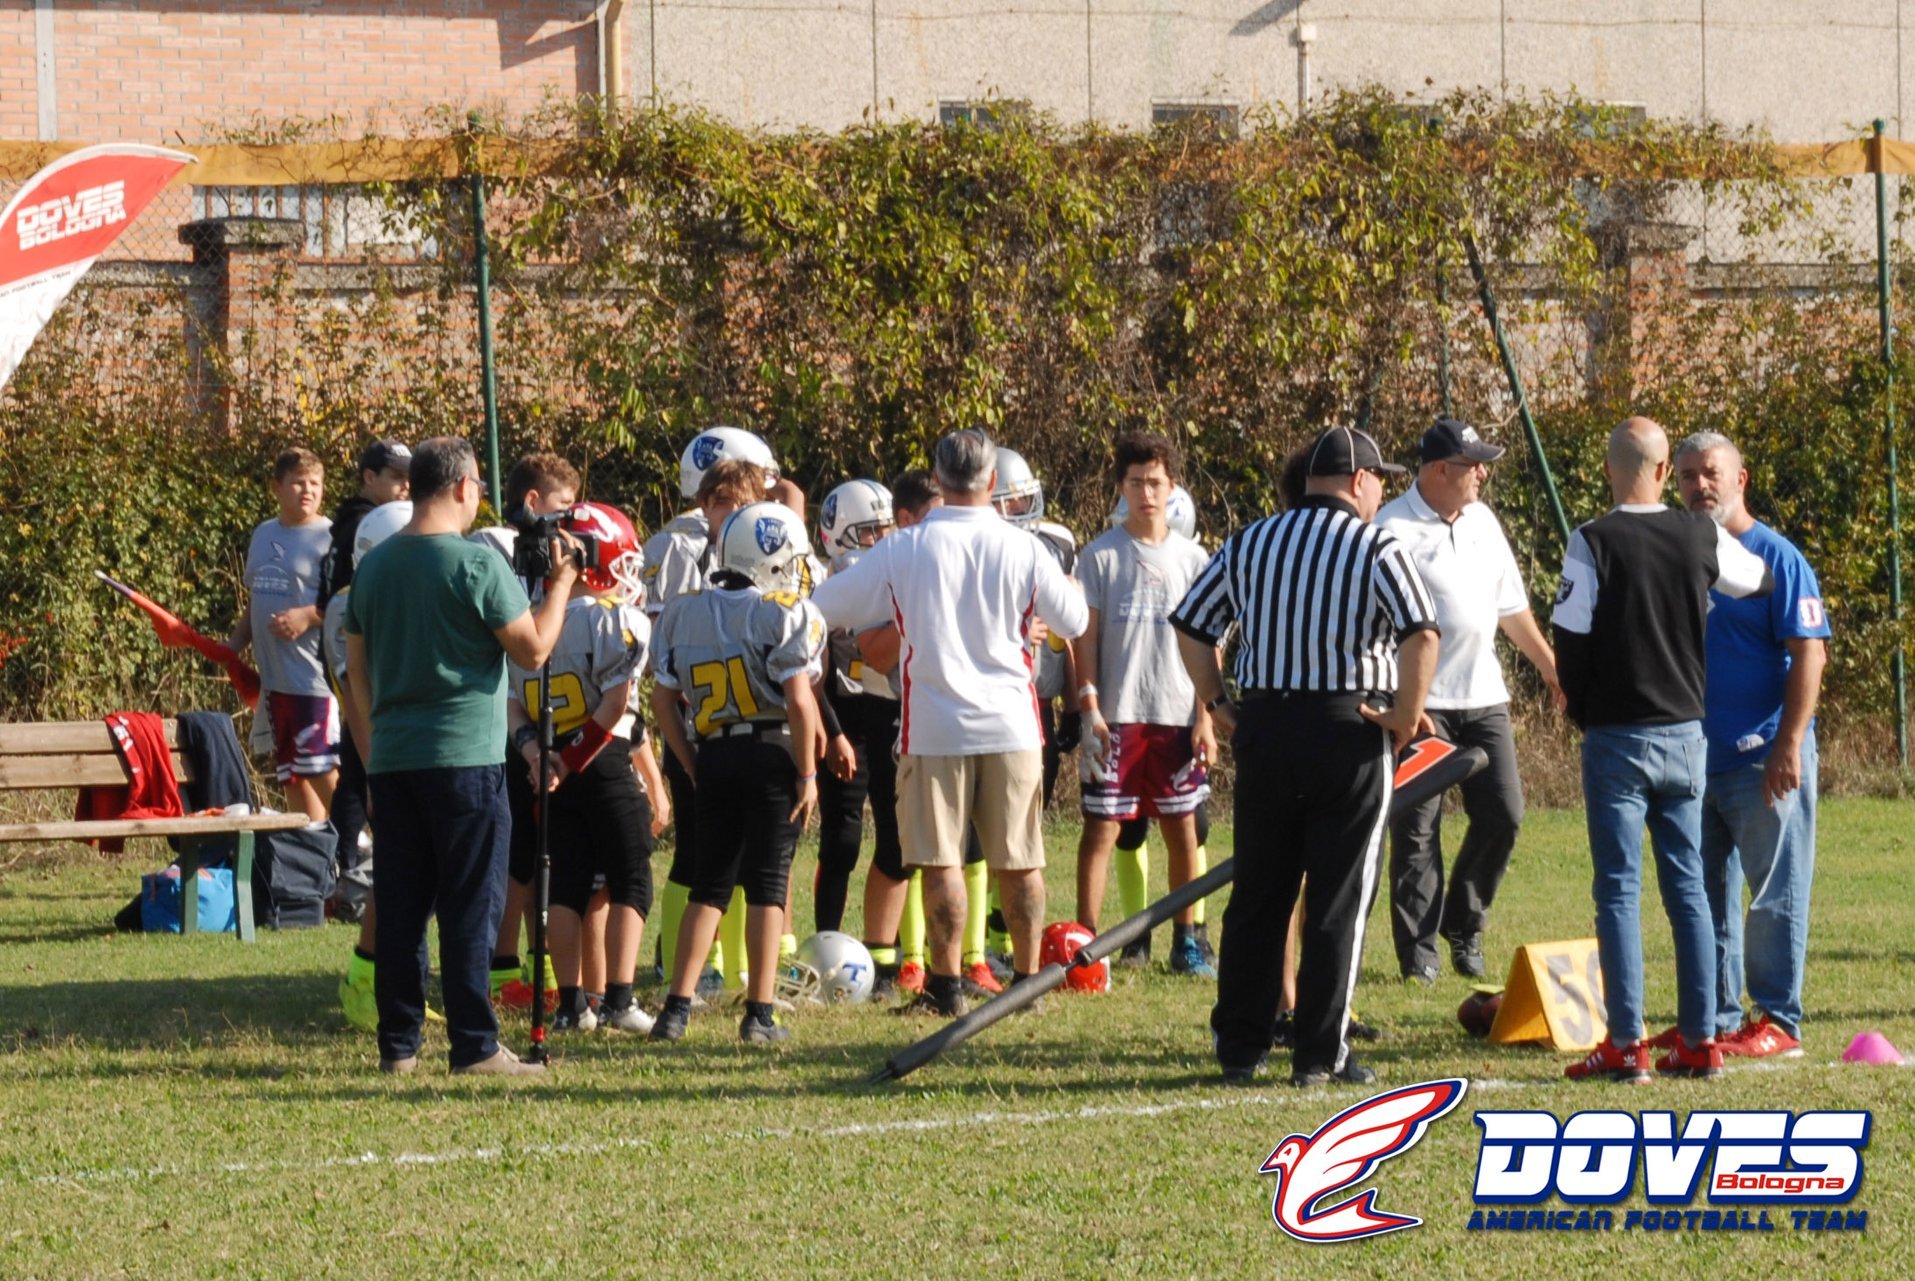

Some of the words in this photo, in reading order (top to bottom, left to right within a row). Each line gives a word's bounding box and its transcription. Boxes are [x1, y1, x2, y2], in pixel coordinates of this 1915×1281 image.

[17, 180, 125, 235] DOVES
[19, 205, 127, 251] BOLOGNA
[690, 655, 759, 736] 21
